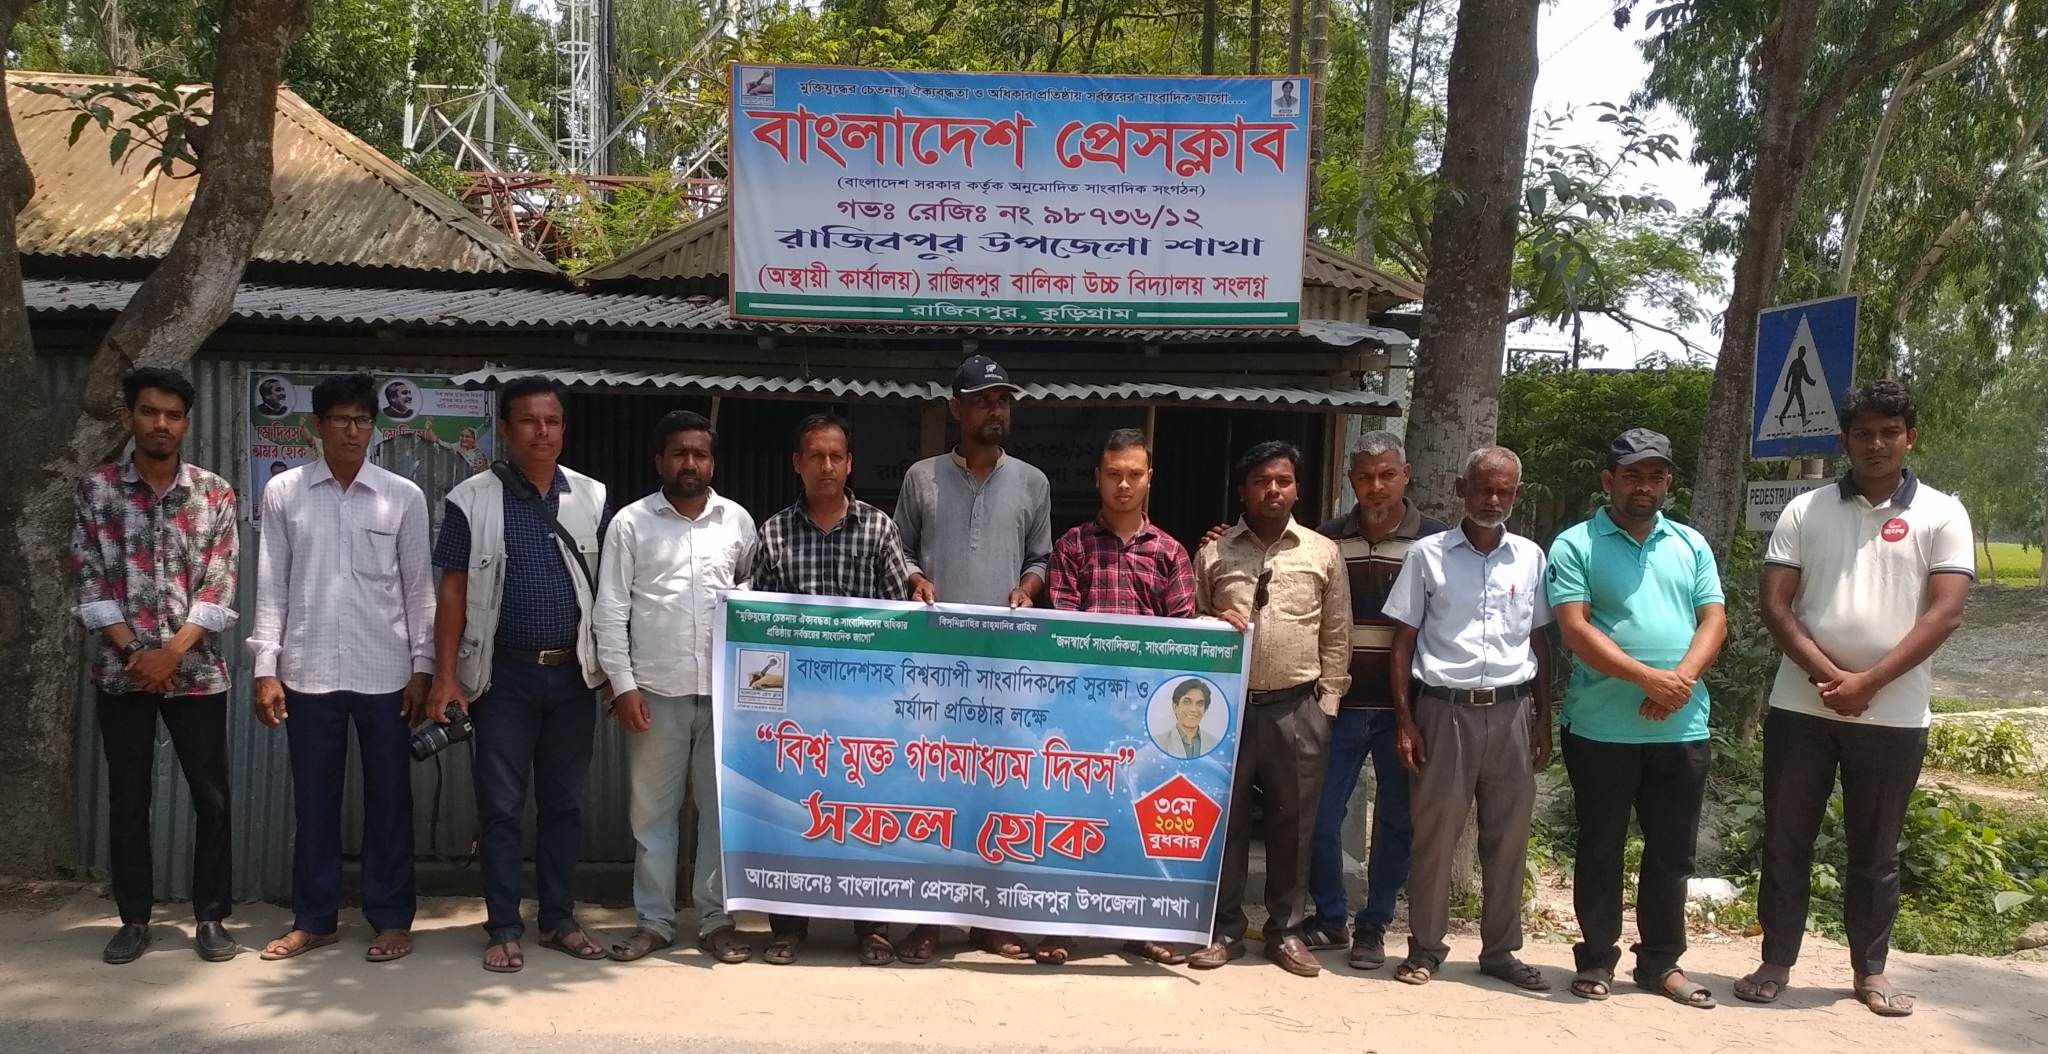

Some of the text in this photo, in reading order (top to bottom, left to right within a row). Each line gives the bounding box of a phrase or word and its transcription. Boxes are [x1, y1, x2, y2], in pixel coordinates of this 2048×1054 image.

[799, 79, 856, 97] মুক্তিযুদ্ধের
[861, 82, 905, 98] চেতনায়
[911, 83, 968, 100] ঐক্যবদ্ধতা
[974, 88, 983, 99] ও
[987, 85, 1033, 101] অধিকার
[1037, 87, 1082, 103] প্রতিষ্ঠায়
[1087, 88, 1136, 103] সর্বস্তরের
[1139, 90, 1192, 105] সাংবাদিক
[744, 104, 1299, 177] বাংলাদেশ প্রেসক্লাব
[838, 176, 1206, 198] (বাংলাদেশ সরকার কর্তৃক অনুমোদিত সাংবাদিক সংগঠন)
[837, 197, 1204, 230] গভঃ রেজিঃ নং ৯৮৭৩৬/১২
[774, 224, 1264, 262] রাজিবপুর উপজেলা শাখা
[758, 261, 1269, 300] (অস্থায়ী কার্যালয়) রাজিবপুর বালিকা উচ্চ বিদ্যালয় সংলগ্ন
[909, 302, 1133, 323] রাজিবপুর, কুড়িগ্রাম
[1145, 639, 1199, 657] সাংবাদিকতায়
[796, 656, 1150, 702] বাংলাদেশসহ বিশ্বব্যাপী সাংবাদিকদের সুরক্ষা ও
[893, 693, 940, 722] মর্যাদা
[944, 696, 1006, 727] প্রতিষ্ঠার
[837, 736, 899, 789] মুক্ত
[905, 734, 1036, 791] গণমাধ্যম
[799, 790, 1110, 864] সফল হোক
[1155, 815, 1195, 834] ২০২৩
[1148, 834, 1203, 850] বুধবার
[744, 868, 832, 894] আয়োজনেঃ
[837, 875, 915, 898] বাংলাদেশ
[920, 879, 990, 908] প্রেসক্লাব,
[997, 882, 1071, 916] রাজিবপুর
[1075, 886, 1146, 917] উপজেলা
